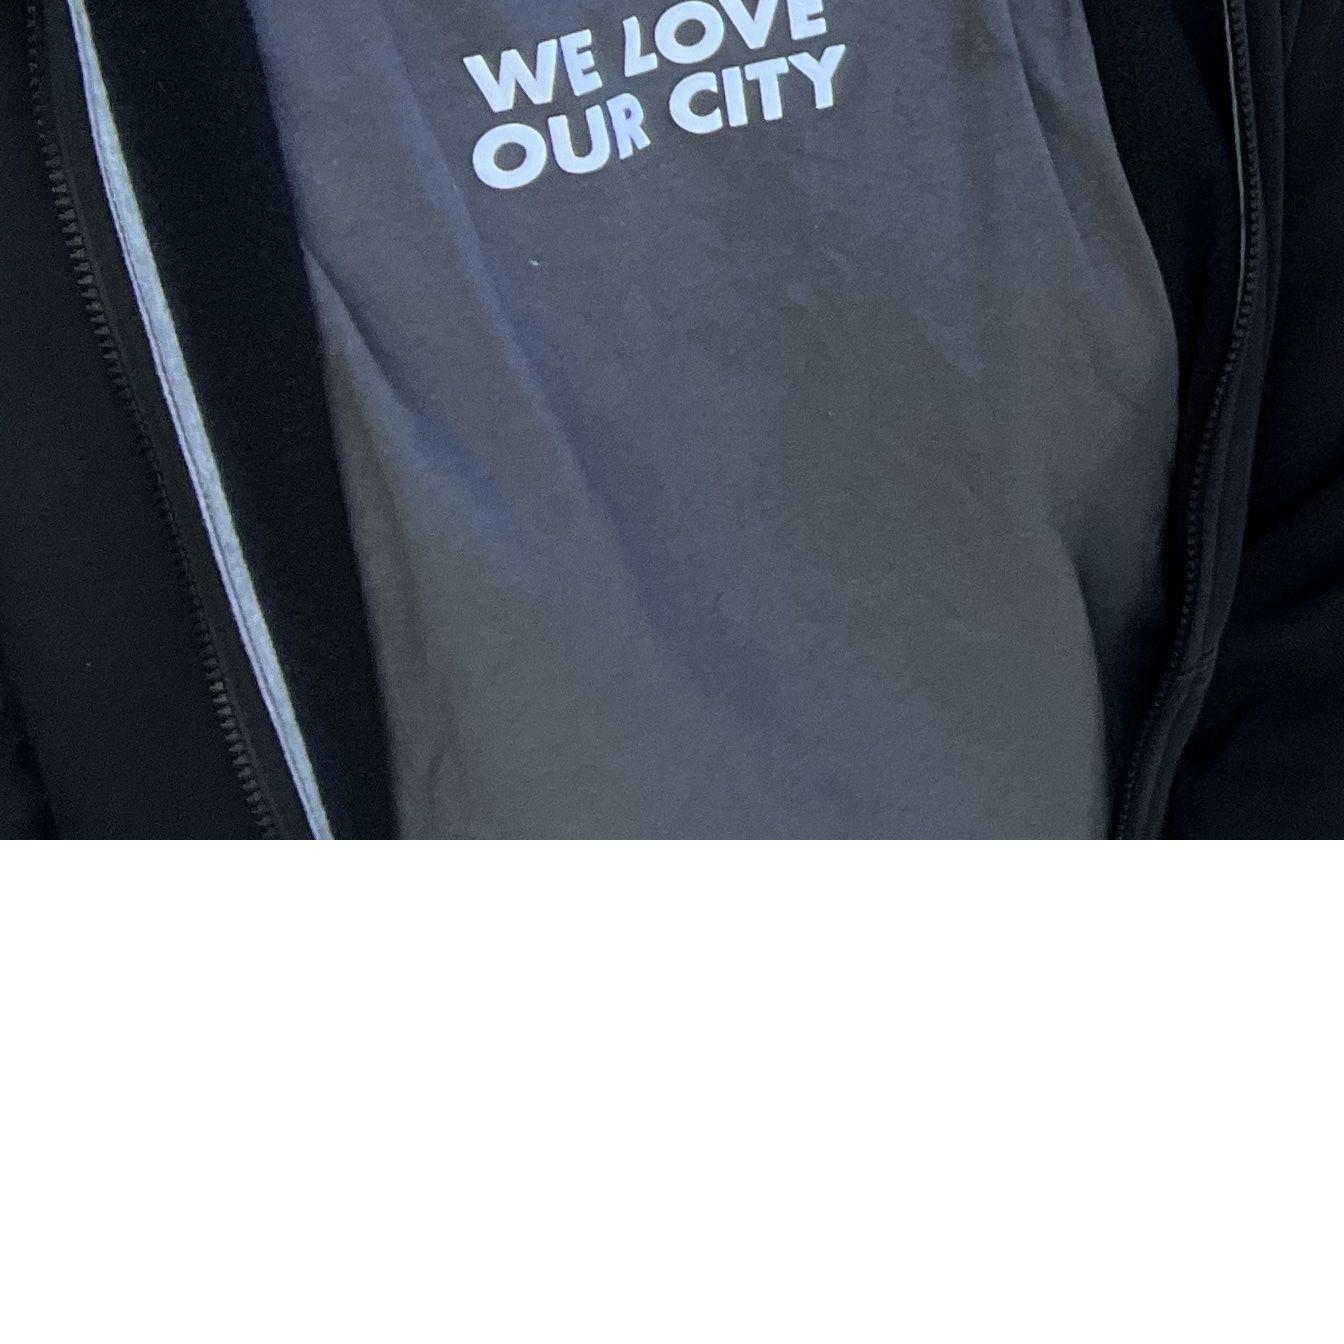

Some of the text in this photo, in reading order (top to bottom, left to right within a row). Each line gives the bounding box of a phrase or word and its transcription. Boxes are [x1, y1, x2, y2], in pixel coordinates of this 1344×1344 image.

[462, 29, 604, 113] WE
[471, 43, 847, 190] OUR CITY
